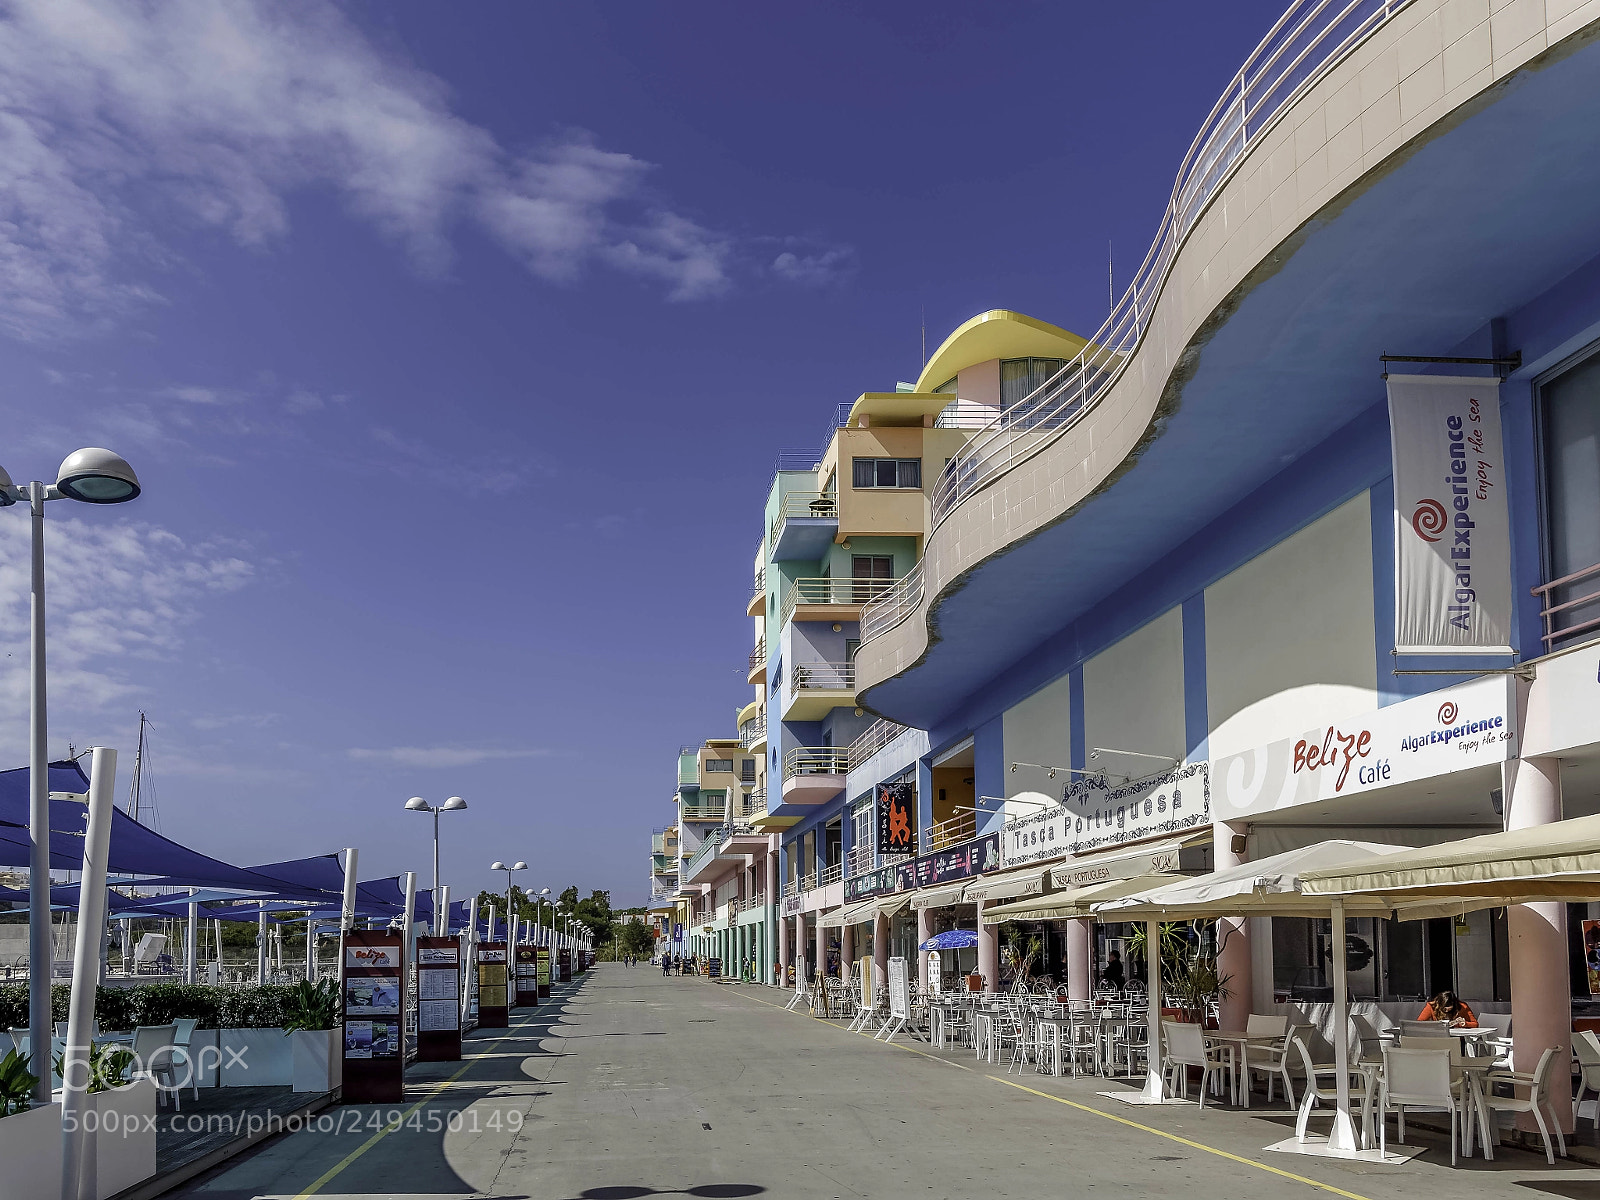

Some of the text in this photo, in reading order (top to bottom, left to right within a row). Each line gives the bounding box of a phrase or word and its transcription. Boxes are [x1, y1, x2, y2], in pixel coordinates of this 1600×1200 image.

[1472, 429, 1484, 455] the
[1476, 461, 1493, 500] Enjoy
[1446, 415, 1476, 630] AlgarExperience
[1400, 714, 1504, 753] AlgarExperience
[1458, 738, 1480, 754] Enjoy
[1482, 731, 1497, 745] the
[1293, 725, 1372, 792] Belize
[1359, 758, 1391, 785] Café
[1014, 789, 1183, 850] Tasca Portuguesa
[1074, 867, 1111, 883] PORTUGUESA
